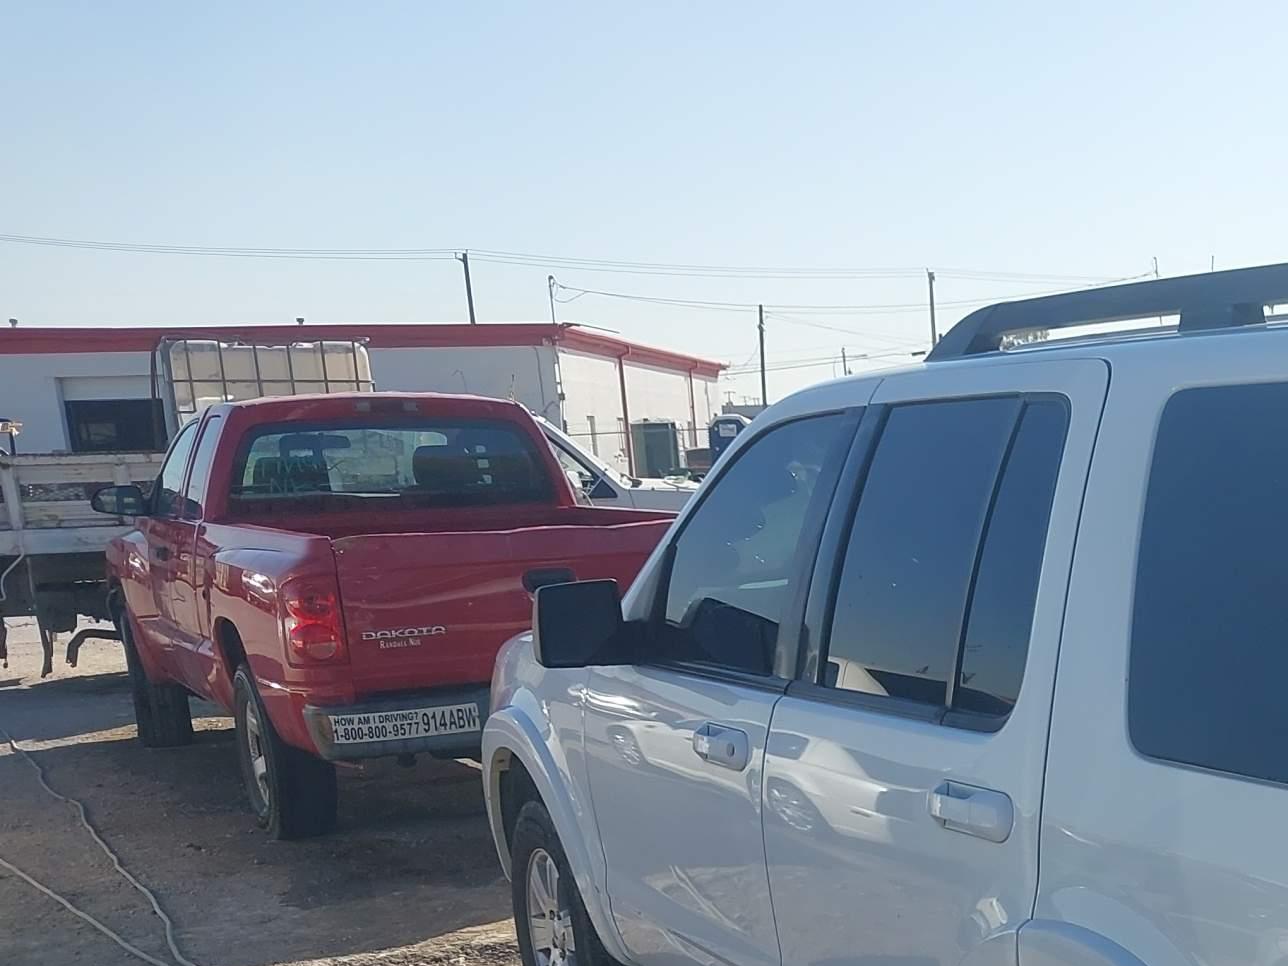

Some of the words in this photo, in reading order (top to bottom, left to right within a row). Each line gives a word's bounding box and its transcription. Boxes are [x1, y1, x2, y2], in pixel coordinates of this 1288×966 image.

[362, 626, 446, 640] DAKOTA
[334, 717, 354, 726] HOW
[358, 716, 370, 725] AM
[379, 711, 419, 723] DRIVING?
[334, 722, 419, 741] 1-800-800-9577
